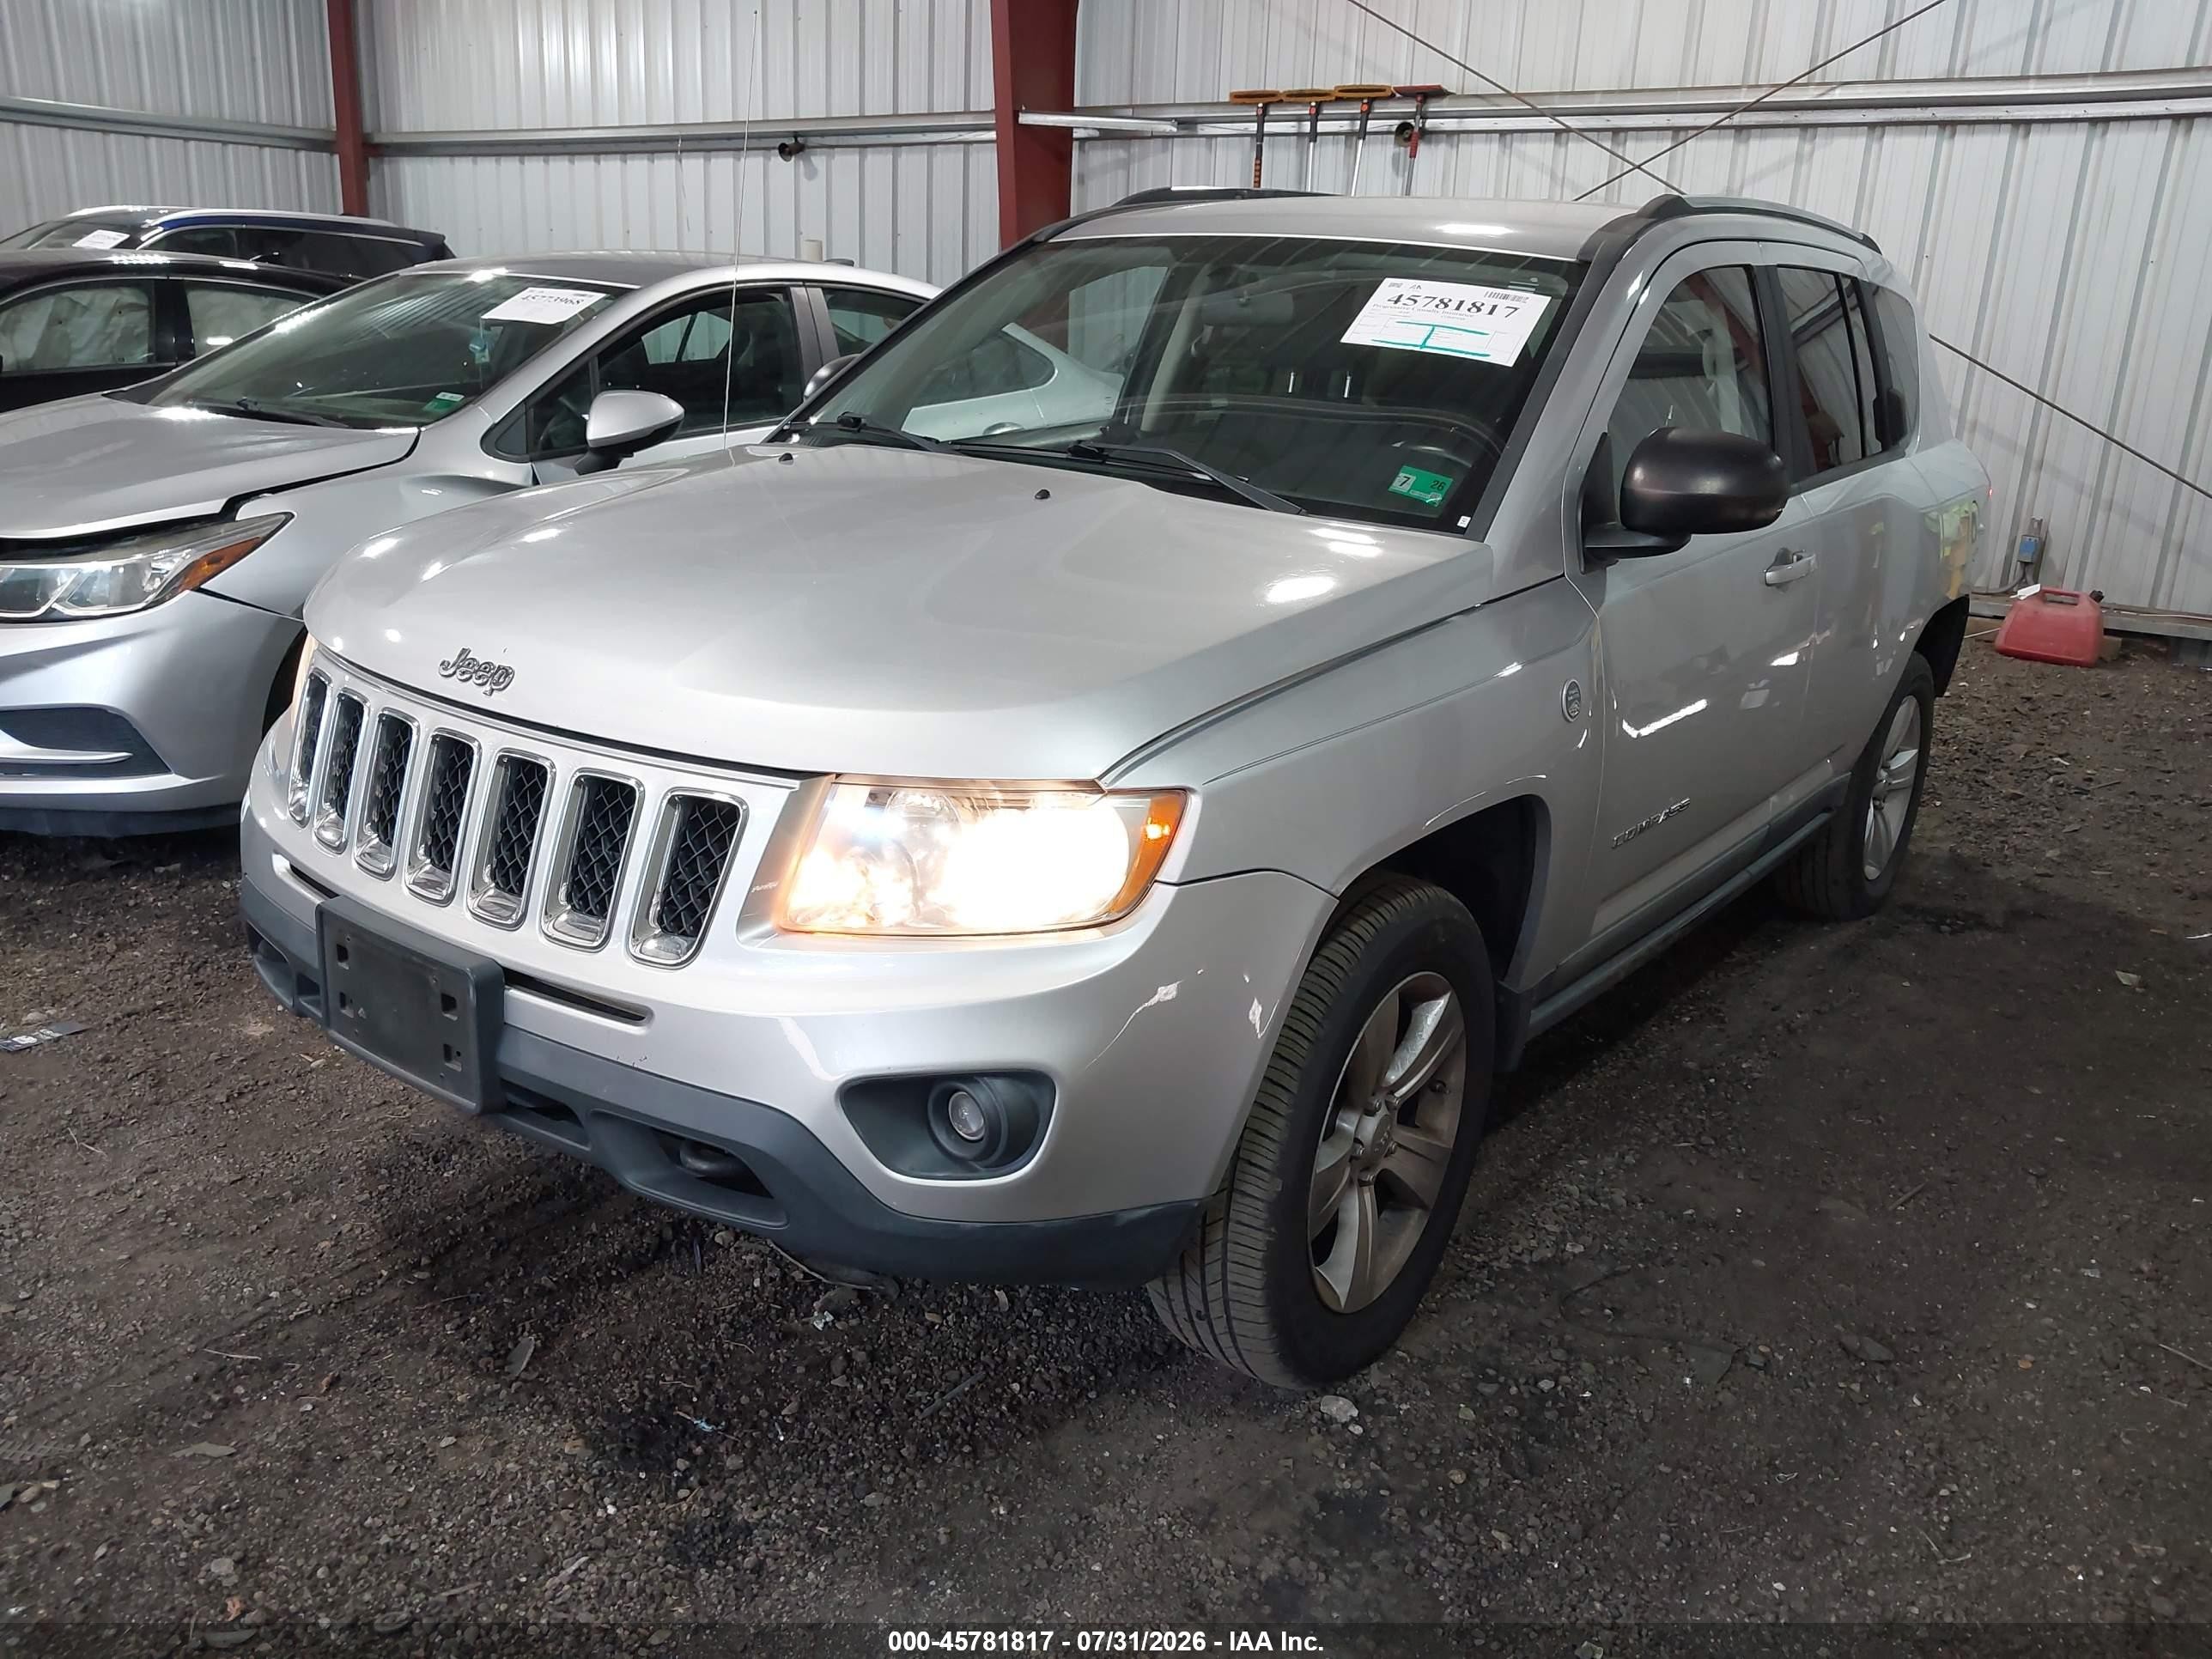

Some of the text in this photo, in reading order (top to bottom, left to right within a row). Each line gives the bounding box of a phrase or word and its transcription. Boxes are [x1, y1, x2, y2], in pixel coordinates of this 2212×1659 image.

[1387, 294, 1521, 319] 45781817
[1400, 476, 1446, 491] 7 26
[438, 647, 515, 696] Jeep
